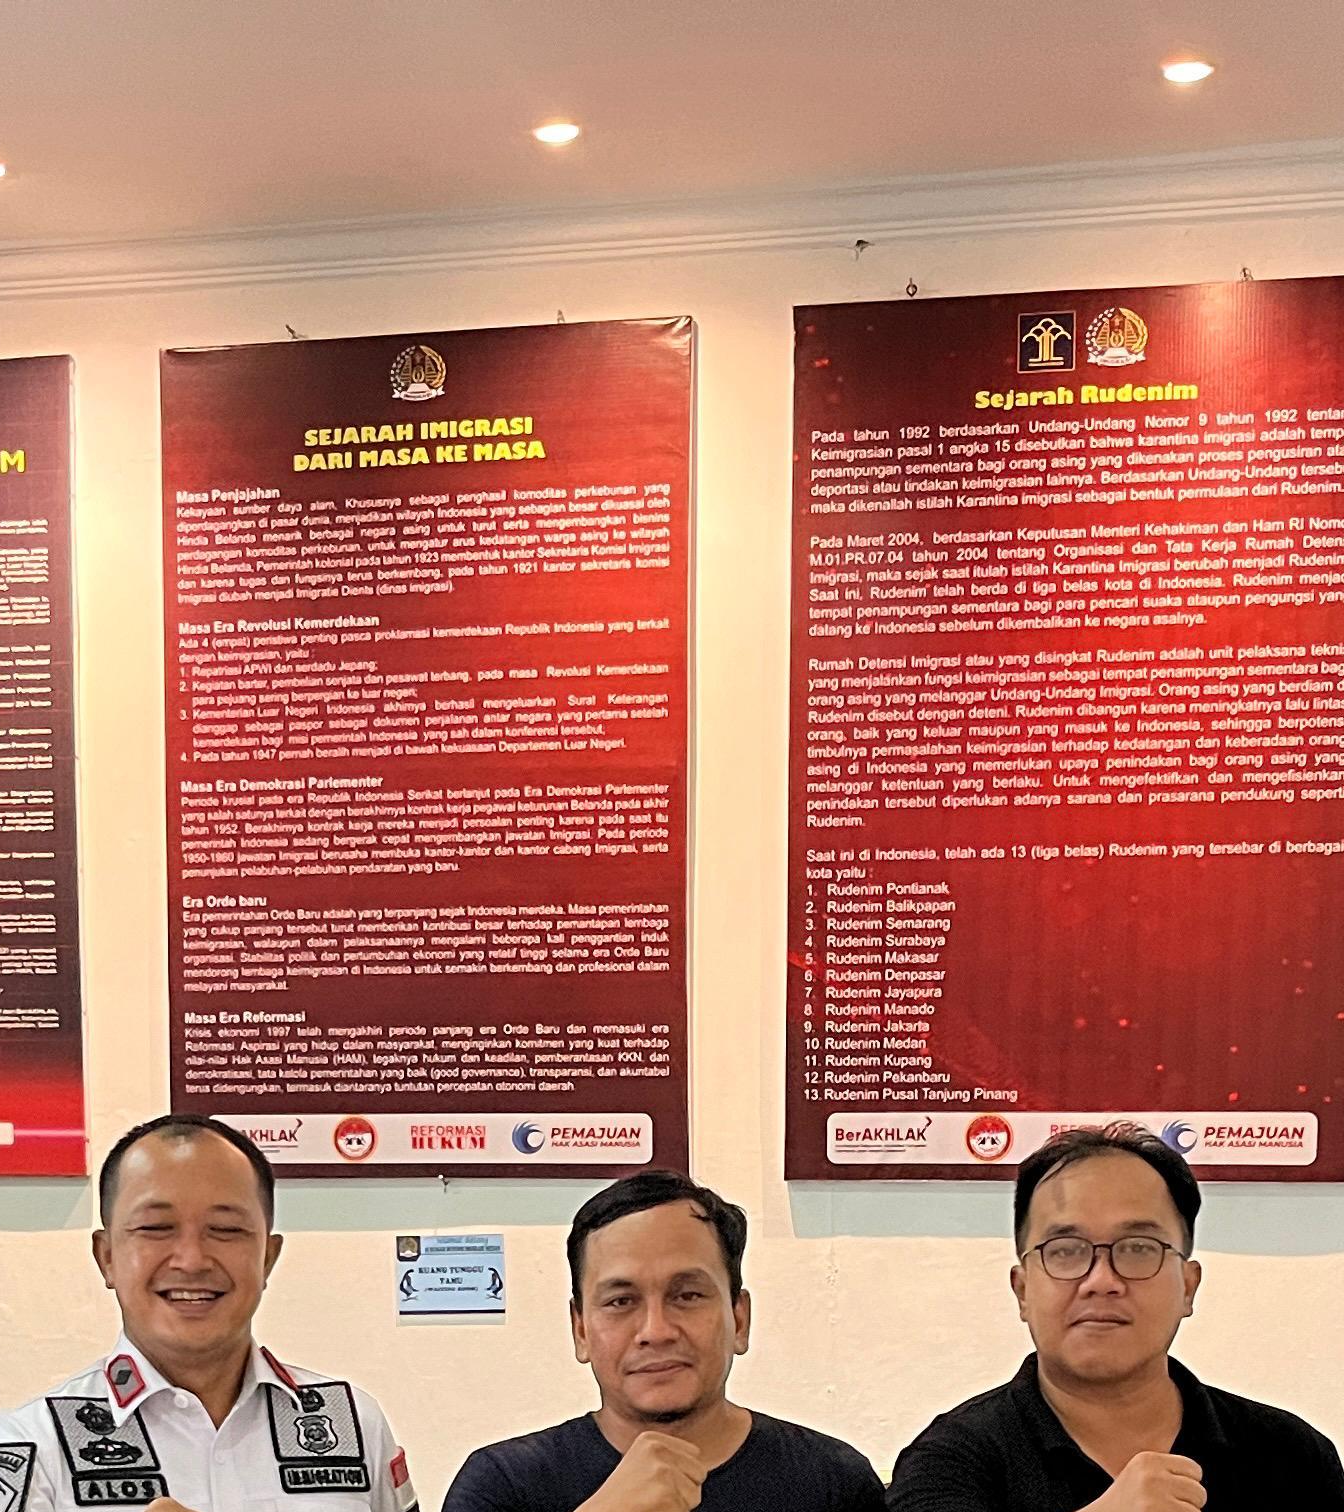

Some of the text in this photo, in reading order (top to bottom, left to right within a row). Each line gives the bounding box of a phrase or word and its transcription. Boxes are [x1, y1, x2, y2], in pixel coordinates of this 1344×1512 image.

[975, 382, 1198, 410] Sejarah Rudenim
[304, 416, 533, 446] SEJARAH IMIGRASI
[811, 430, 845, 443] Pada
[854, 429, 889, 441] tahun
[899, 426, 930, 439] 1992
[939, 422, 1019, 438] berdasarkan
[1029, 417, 1135, 434] Undang-Undang
[1145, 415, 1190, 428] Nomor
[1198, 413, 1207, 426] 9
[1216, 412, 1254, 425] tahun
[1265, 409, 1297, 422] 1992
[811, 446, 893, 462] Keimigrasian
[897, 443, 932, 459] pasal
[938, 443, 944, 455] 1
[949, 441, 989, 456] angka
[994, 440, 1010, 452] 15
[1014, 437, 1085, 452] disebutkan
[1090, 434, 1133, 449] bahwa
[1138, 433, 1199, 447] karantina
[1259, 428, 1305, 442] adalah
[293, 441, 546, 472] DARI MASA KE MASA
[177, 486, 280, 502] Masa Penjajahan
[179, 615, 380, 635] Masa Era Revolusi Kemerdekaan
[181, 775, 383, 793] Masa Era Demokrasi Parlementer
[806, 849, 835, 862] Saat
[839, 848, 854, 861] ini
[859, 848, 870, 861] di
[944, 847, 976, 859] telah
[981, 846, 1004, 859] ada
[1011, 845, 1026, 858] 13
[1031, 845, 1059, 860] (tiga
[1064, 844, 1104, 859] belas)
[1109, 843, 1167, 856] Rudenim
[1172, 843, 1204, 858] yang
[1209, 841, 1264, 855] tersebar
[1269, 840, 1281, 854] di
[1286, 839, 1344, 856] berbagai
[806, 866, 866, 881] kota yaitu
[806, 882, 949, 896] 1. Rudenim Pontianak
[183, 894, 266, 909] Era Orde baru
[805, 899, 956, 914] 2. Rudenim Balikpapan
[805, 917, 951, 931] 3. Rudenim Semarang
[826, 935, 882, 947] Rudenim
[885, 934, 945, 949] Surabaya
[805, 951, 939, 965] 5. Rudenim Makasar
[805, 969, 946, 984] 6. Rudenim Denpasar
[826, 986, 880, 998] Rudenim
[884, 986, 942, 1001] Jayapura
[825, 1003, 880, 1015] Rudenim
[884, 1003, 935, 1015] Manado
[185, 1010, 305, 1024] Masa Era Reformasi
[804, 1020, 930, 1033] 9. Rudenim Jakarta
[825, 1037, 880, 1049] Rudenim
[883, 1037, 926, 1049] Medan
[804, 1054, 932, 1069] 11. Rudenim Kupang
[804, 1071, 950, 1084] 12. Rudenim Pekanbaru
[804, 1088, 1018, 1102] 13. Rudenim Pusat Tanjung Pinang
[241, 1125, 299, 1142] AKHLAK
[411, 1126, 486, 1135] REFORMASI
[551, 1128, 641, 1138] PEMAJUAN
[835, 1122, 929, 1142] BerAKHLAK
[1204, 1126, 1305, 1139] PEMAJUAN
[412, 1137, 485, 1149] HUKUM
[1228, 1140, 1256, 1148] ASASI
[1259, 1140, 1304, 1148] MANUSIA
[88, 1481, 155, 1498] ALOS
